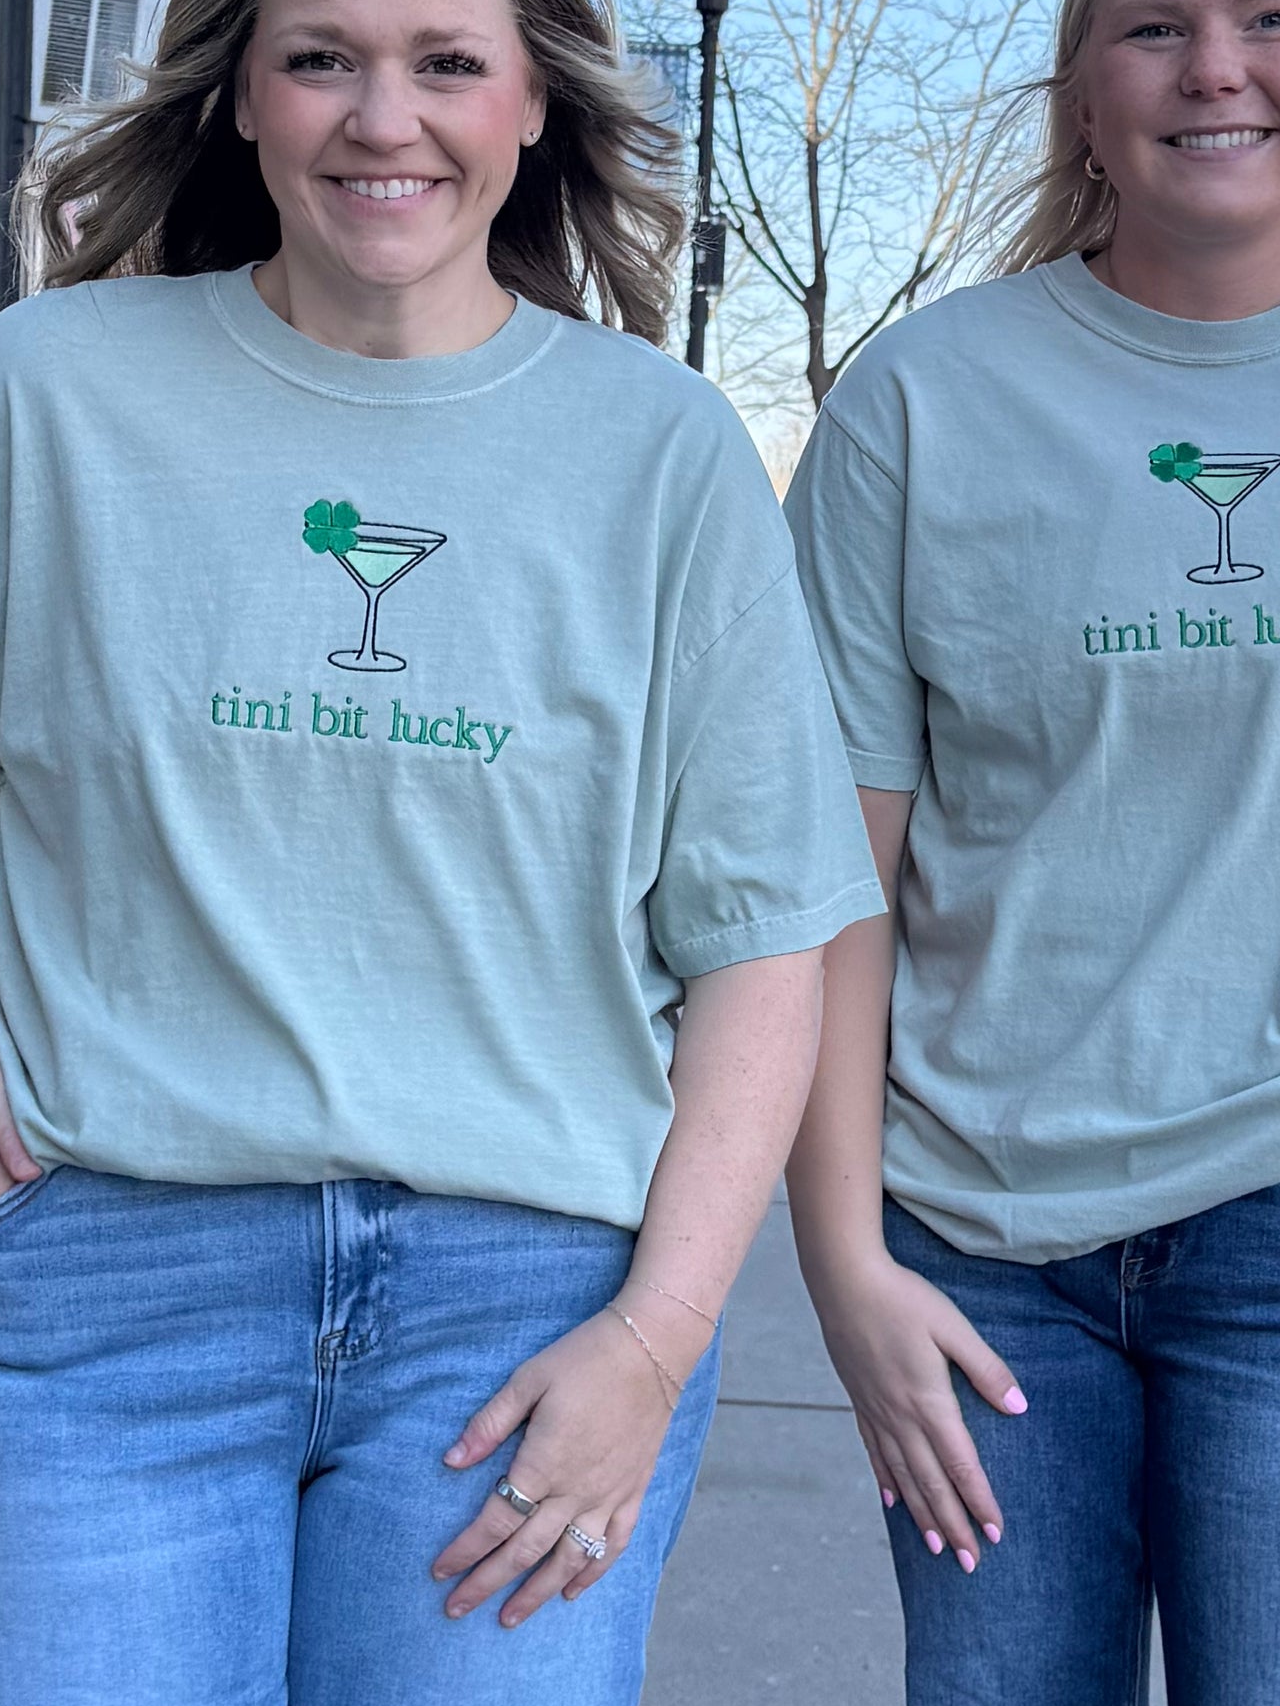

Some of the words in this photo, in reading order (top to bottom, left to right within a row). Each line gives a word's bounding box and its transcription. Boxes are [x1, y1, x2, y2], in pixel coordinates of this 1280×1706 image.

[1083, 614, 1161, 656] tini
[1175, 608, 1236, 649] bit
[211, 686, 292, 733] tini
[311, 692, 368, 739] bit
[388, 699, 513, 764] lucky
